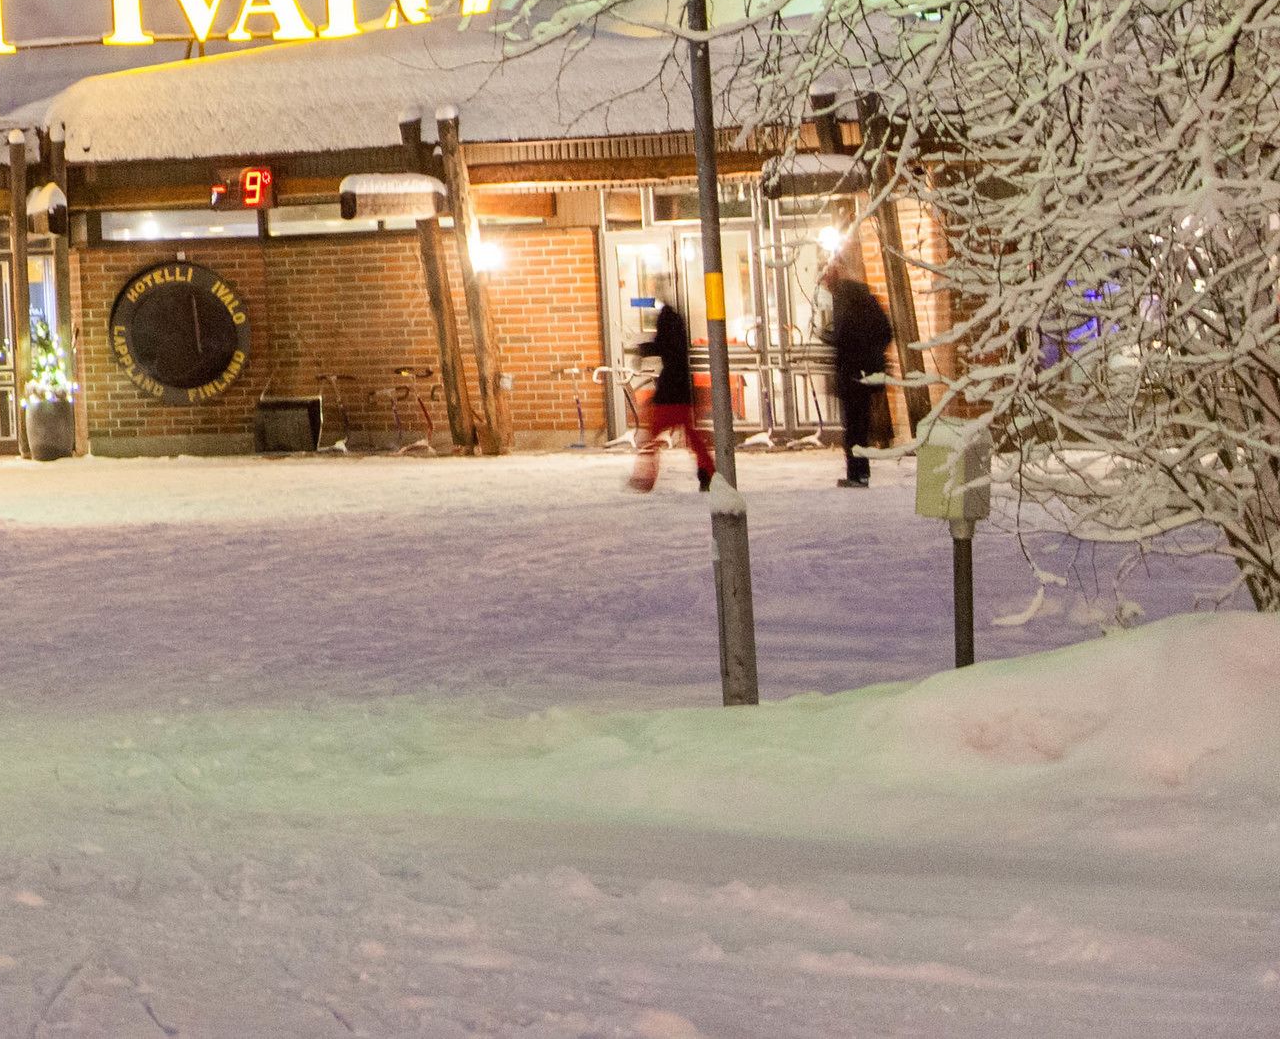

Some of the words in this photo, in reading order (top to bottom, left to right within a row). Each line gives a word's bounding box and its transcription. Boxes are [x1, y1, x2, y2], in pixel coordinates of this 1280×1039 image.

[126, 267, 193, 303] HOTELLI
[211, 280, 246, 325] IVALO
[113, 325, 164, 397] LAPPLAND
[187, 350, 246, 402] FINLAND
